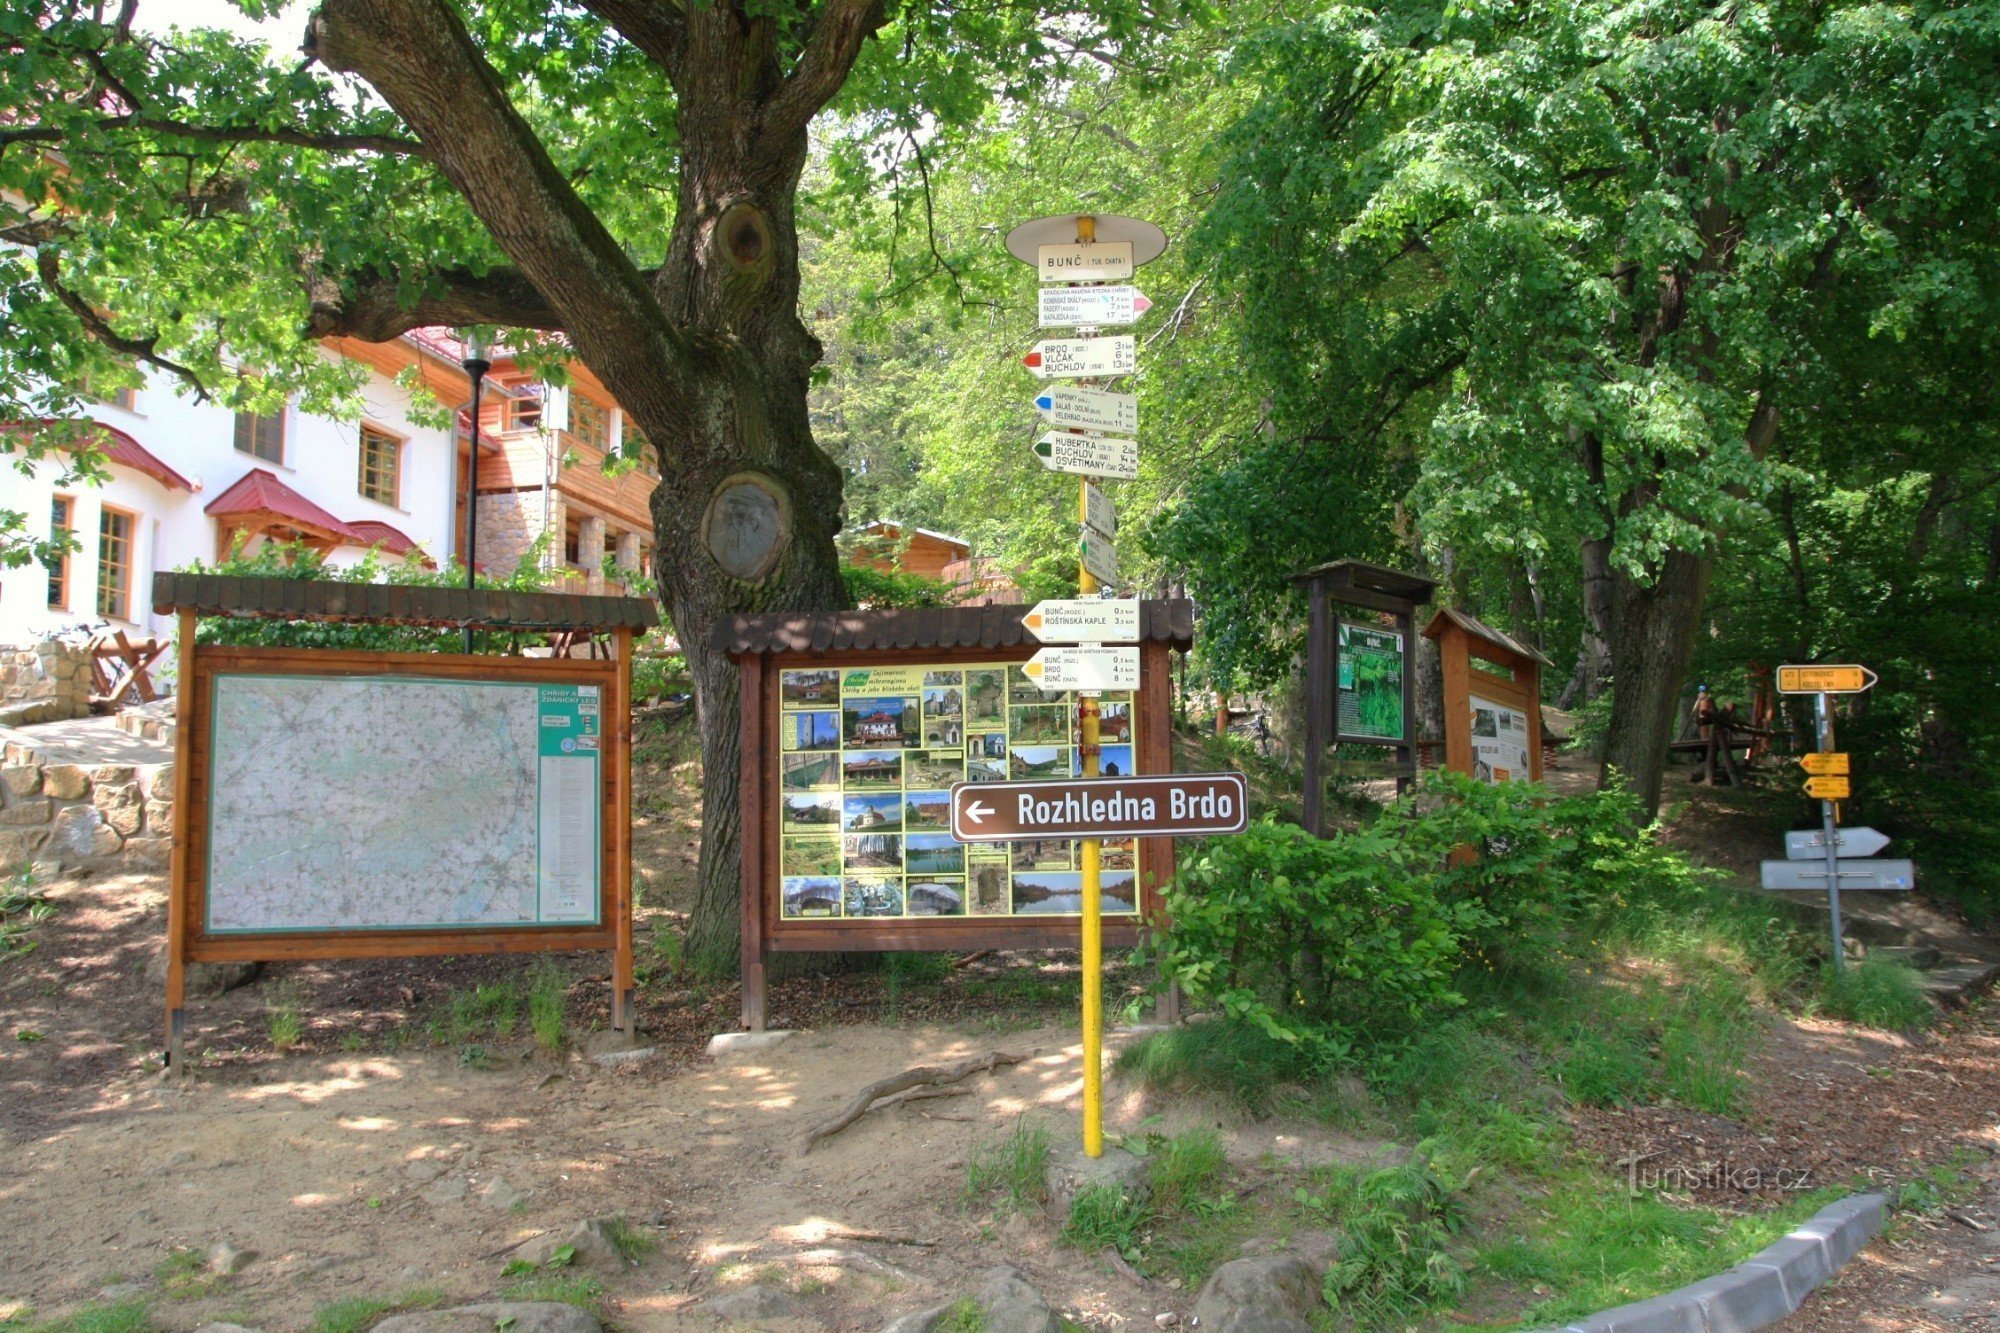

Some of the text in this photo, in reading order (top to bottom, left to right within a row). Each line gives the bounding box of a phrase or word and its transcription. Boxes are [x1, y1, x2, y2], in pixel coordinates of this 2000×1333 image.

[1048, 255, 1081, 268] BUNČ
[1045, 345, 1068, 354] BRDO
[1115, 351, 1122, 359] 6
[1045, 362, 1086, 372] BUCHLOV
[1055, 437, 1097, 450] HUBERTKA
[1055, 447, 1094, 459] BUCHLOV
[1045, 606, 1064, 615] BUNČ
[1084, 617, 1106, 625] KAPLE
[1044, 656, 1061, 664] BUNČ
[1044, 674, 1061, 682] BUNČ
[1018, 787, 1232, 825] Rozhledna Brdo
